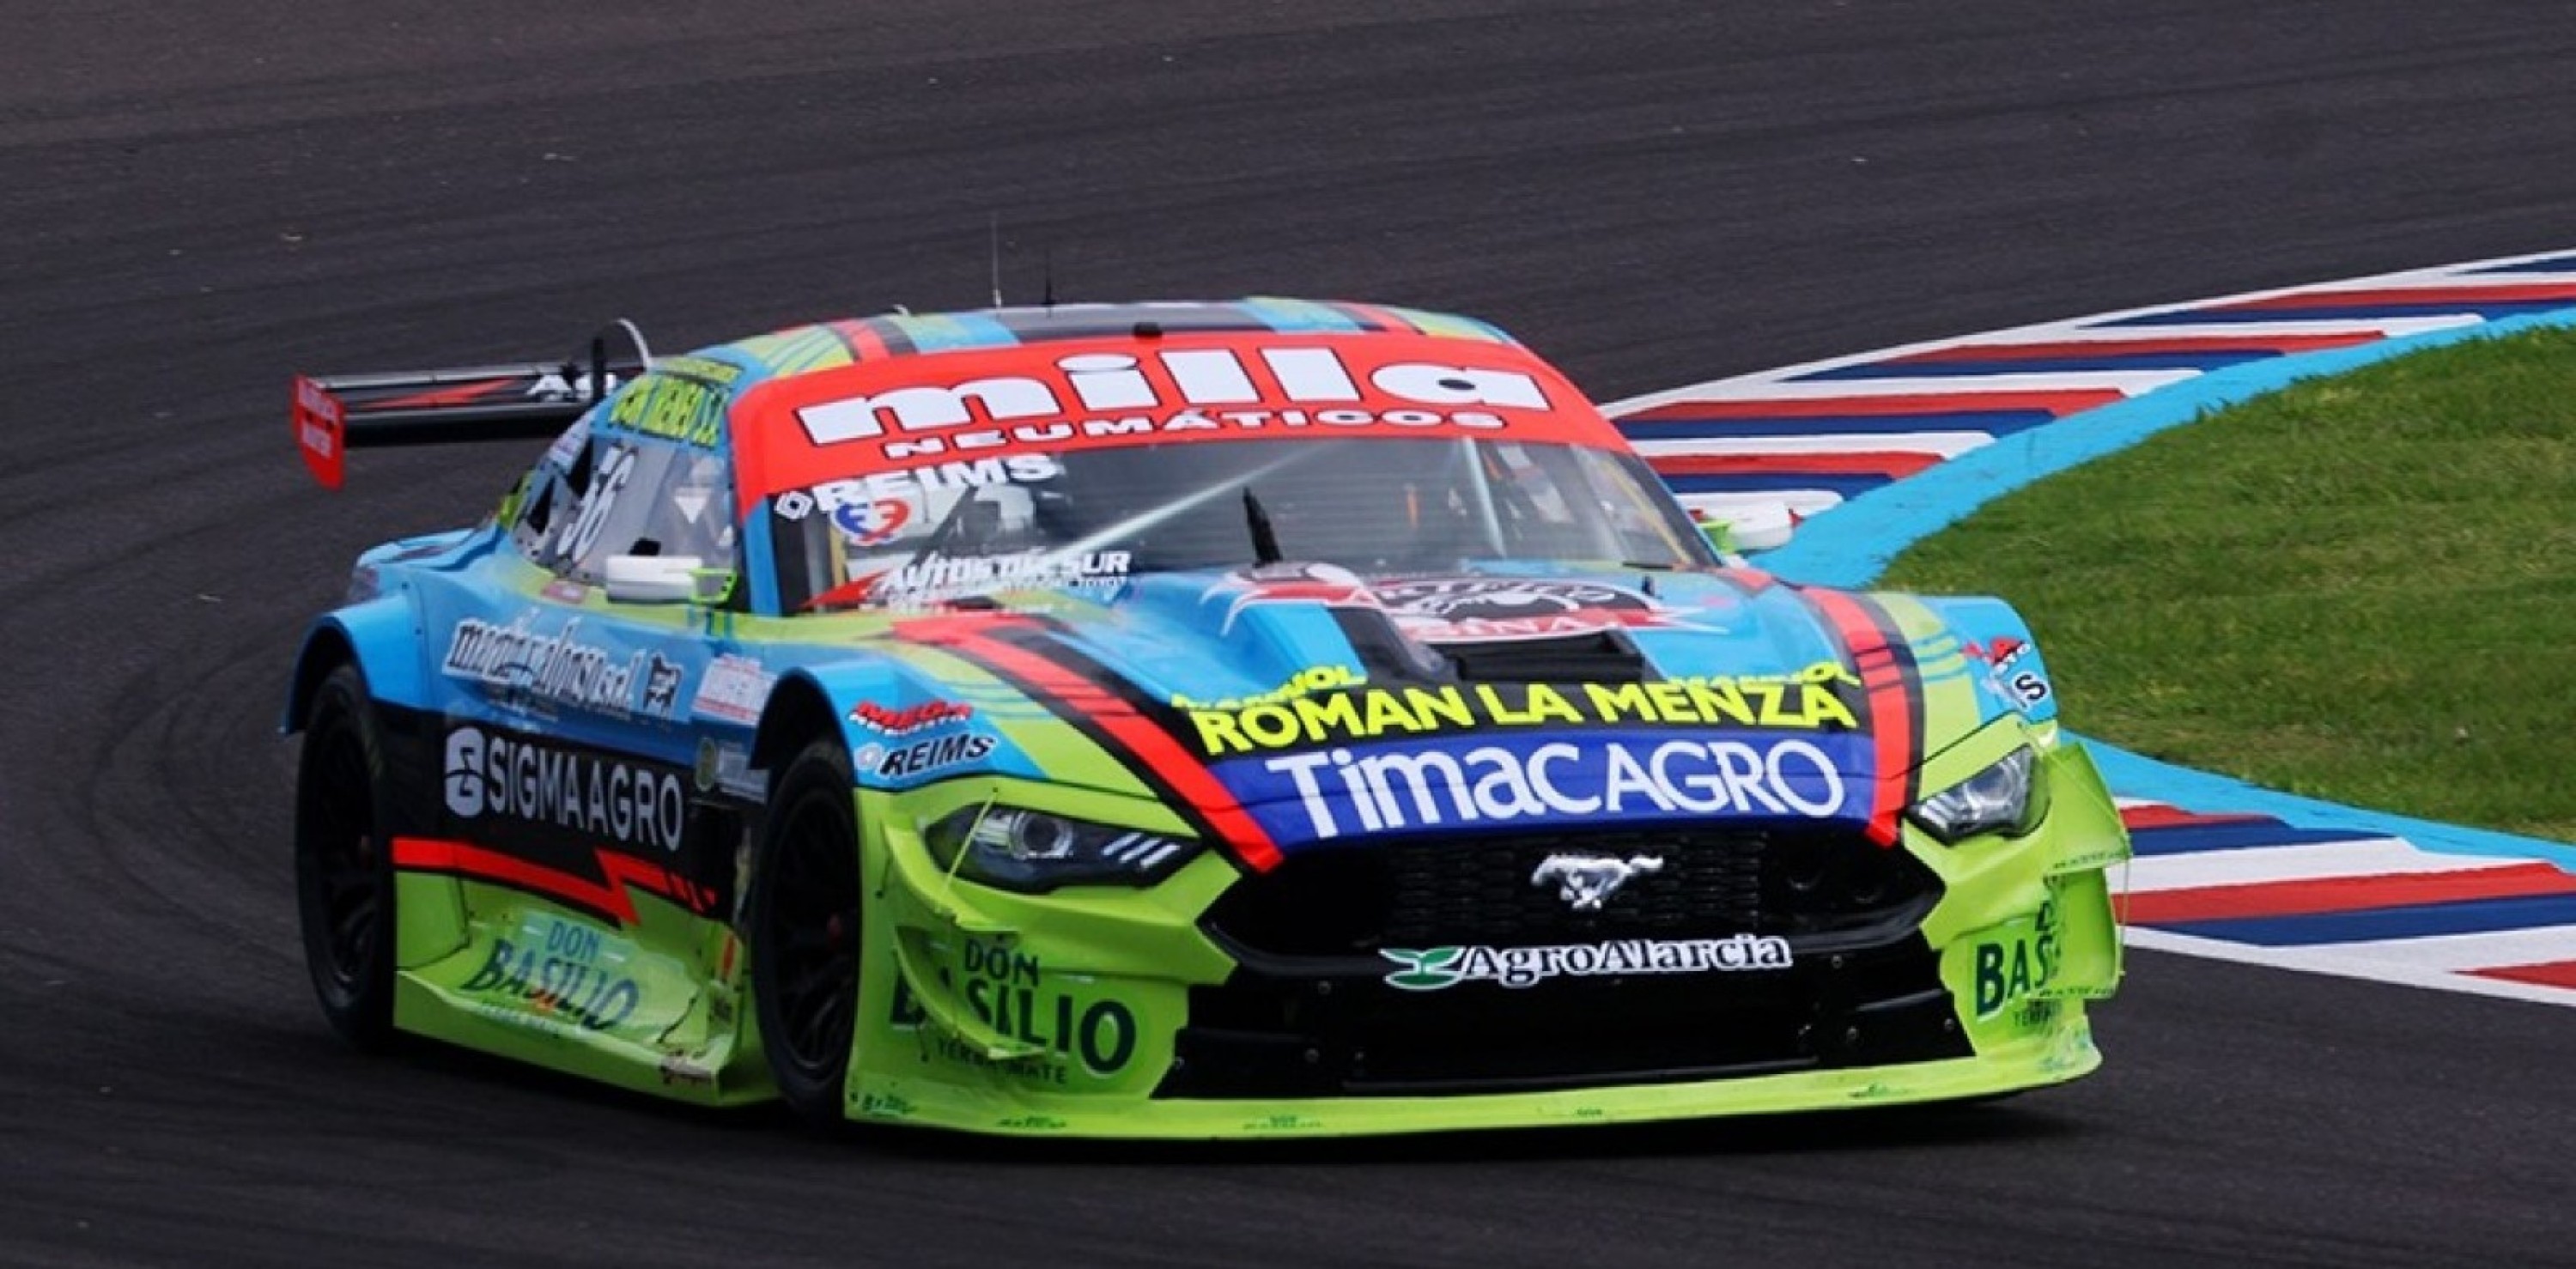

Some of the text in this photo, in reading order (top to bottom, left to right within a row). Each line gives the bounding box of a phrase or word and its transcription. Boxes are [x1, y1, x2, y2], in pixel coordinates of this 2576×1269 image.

[795, 347, 1551, 445] milla
[882, 409, 1507, 460] NEUMÁTICOS
[811, 453, 1057, 514] REIMS
[1189, 685, 1475, 756] ROMAN
[1475, 683, 1584, 725] LA
[1584, 682, 1858, 729] MENZA
[877, 732, 998, 778] REIMS
[545, 920, 600, 962] DON
[964, 938, 1039, 987] DON
[1460, 933, 1794, 988] AgroAlarcia
[890, 966, 1137, 1075] BSILIO
